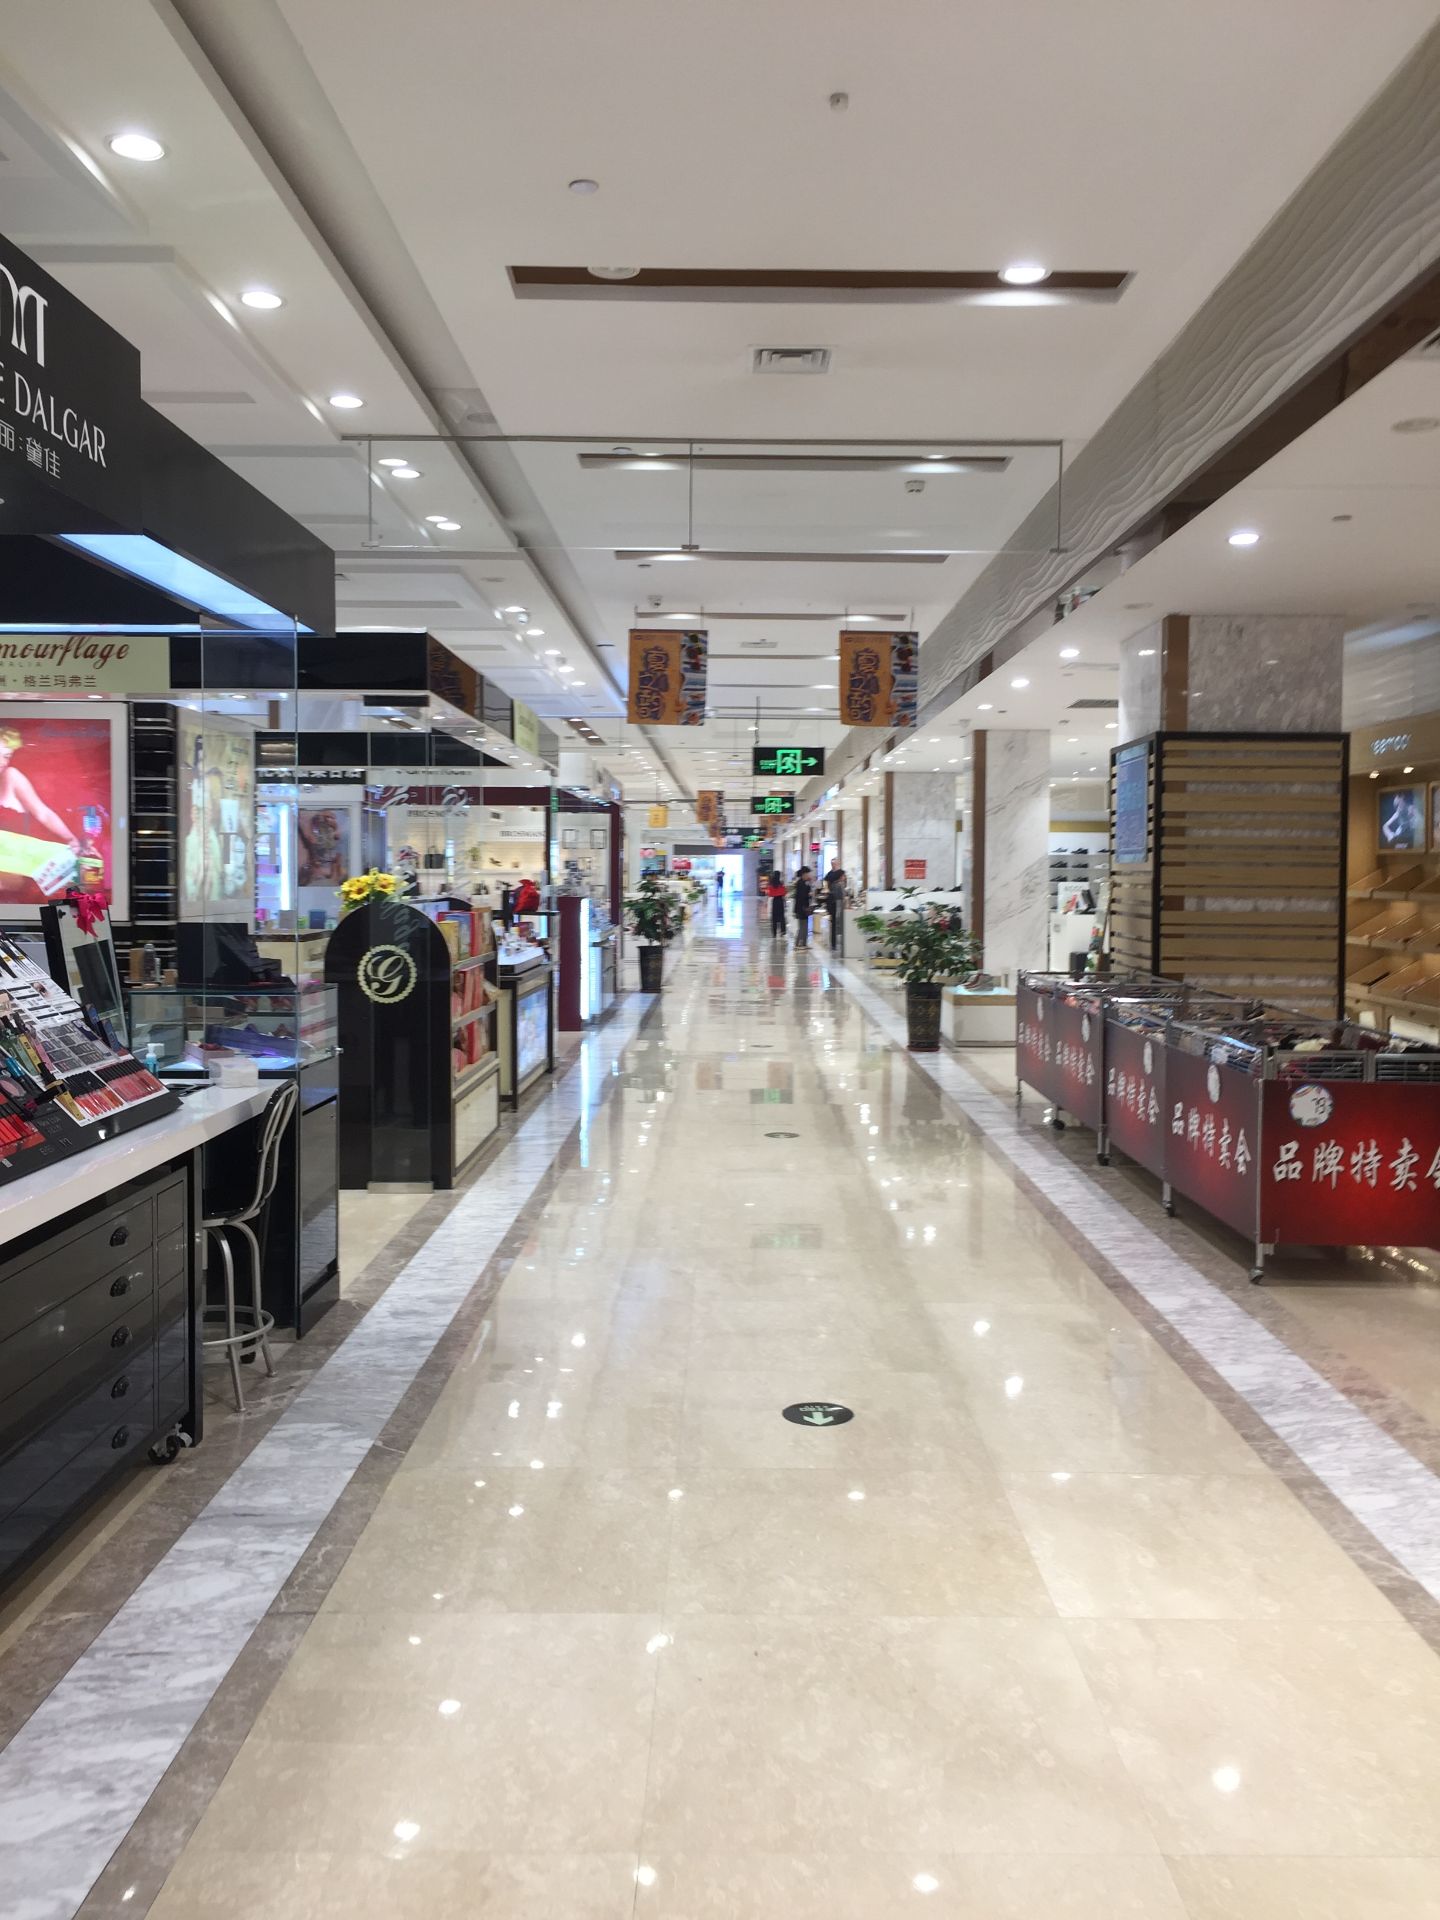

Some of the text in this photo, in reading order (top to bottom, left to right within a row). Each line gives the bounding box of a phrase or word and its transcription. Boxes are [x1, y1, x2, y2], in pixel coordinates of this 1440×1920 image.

[14, 371, 107, 469] DALGAR
[1107, 1067, 1159, 1126] 品牌特卖会
[1172, 1101, 1251, 1176] 品牌特卖会
